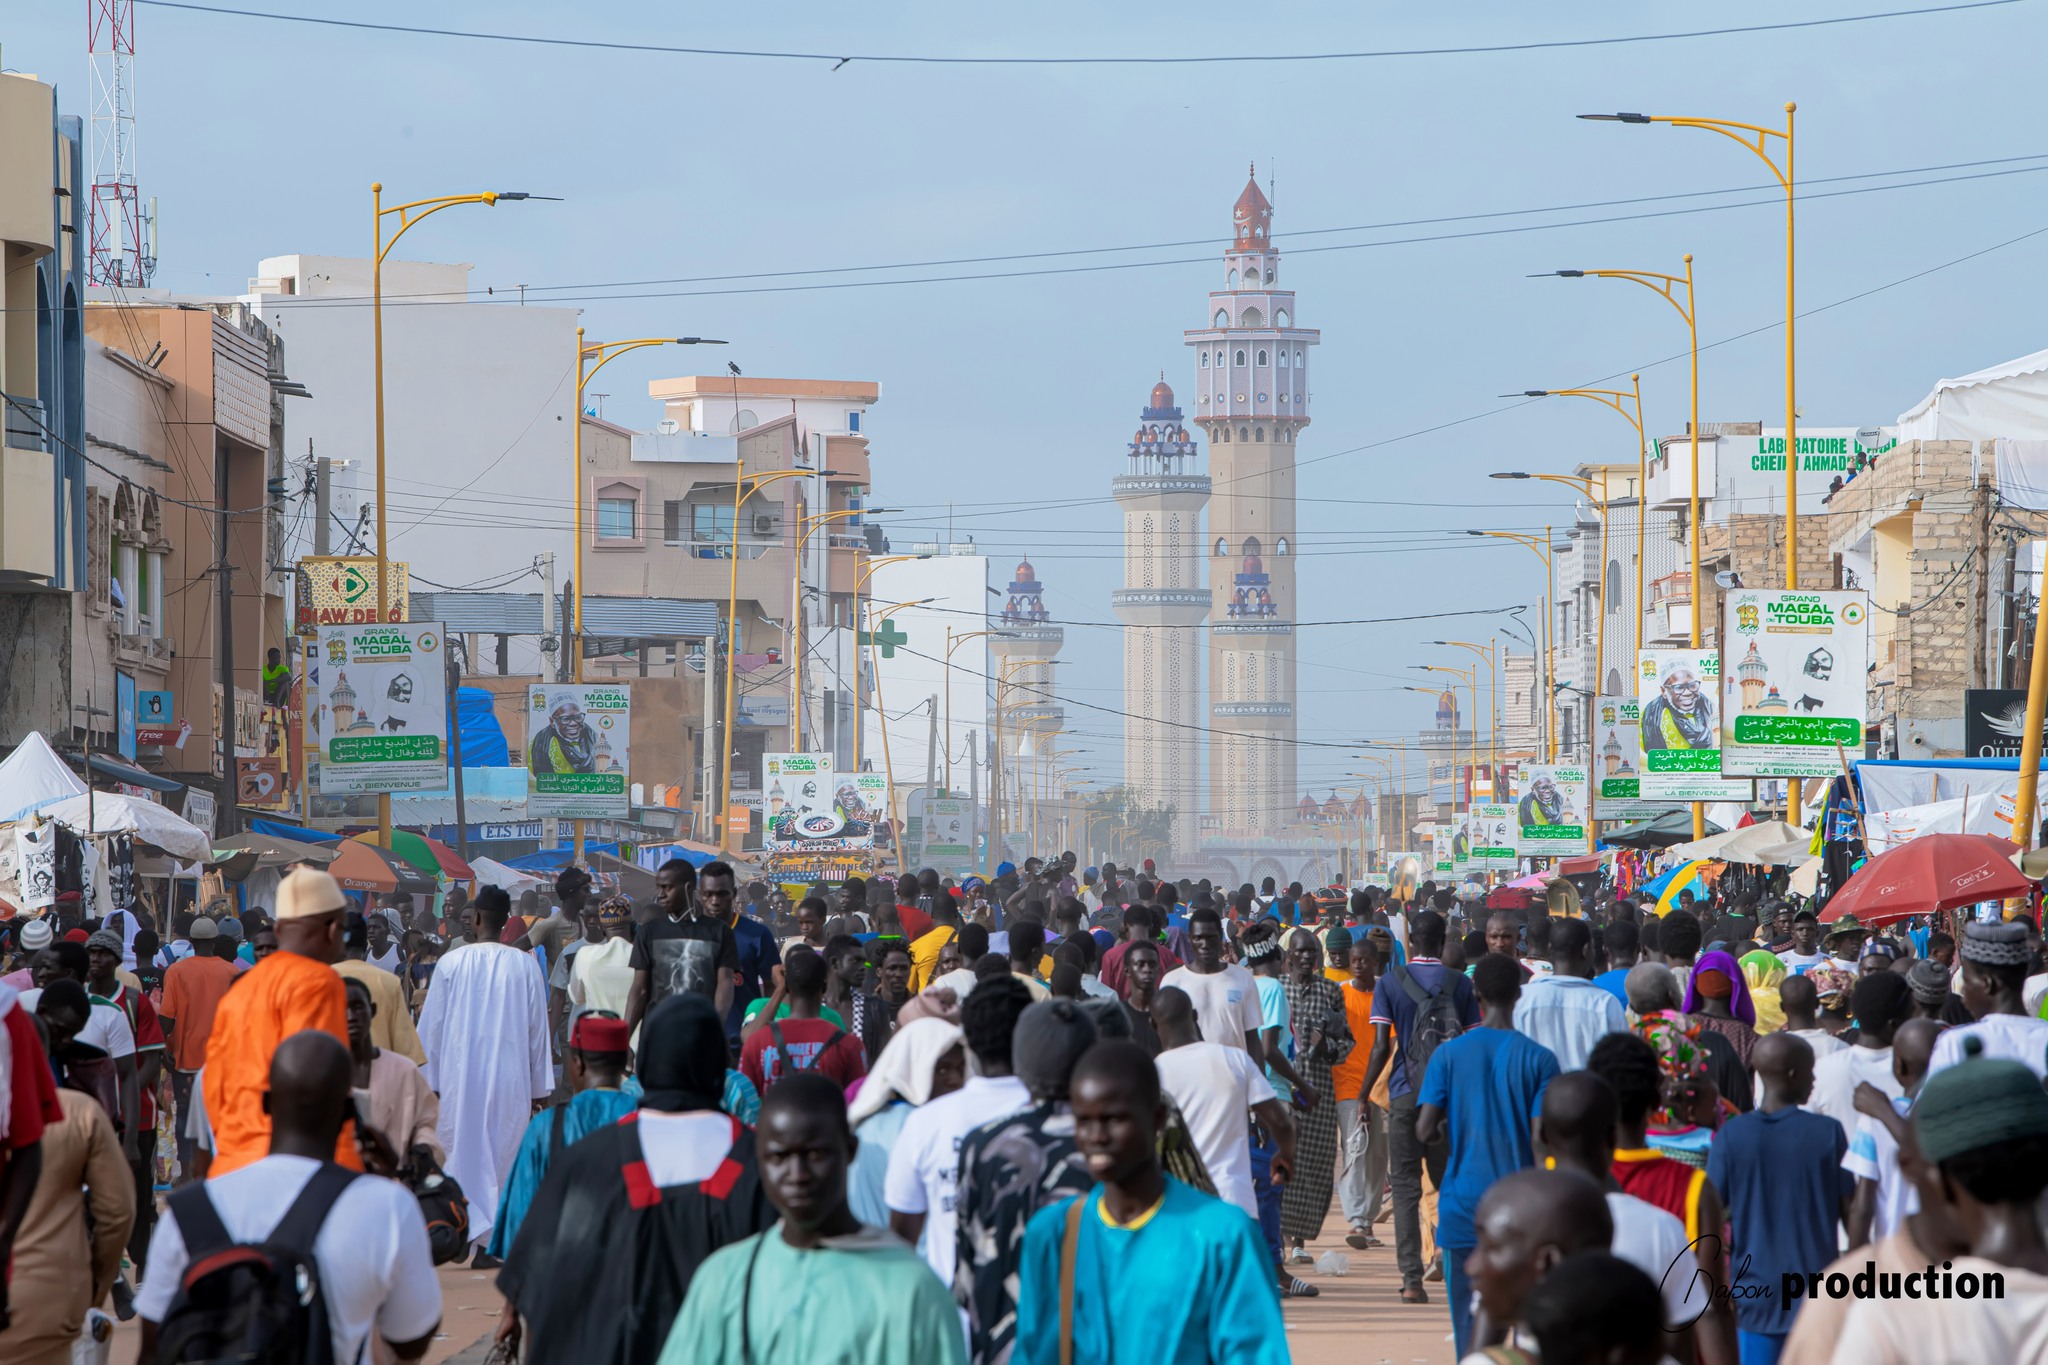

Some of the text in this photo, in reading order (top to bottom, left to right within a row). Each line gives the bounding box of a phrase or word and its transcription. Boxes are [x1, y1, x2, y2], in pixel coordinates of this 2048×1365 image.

[1759, 438, 1847, 454] LABRATOIRE
[1752, 456, 1799, 471] CHEI
[1781, 595, 1821, 603] GRAND
[1767, 603, 1834, 615] MAGAL
[300, 608, 401, 623] DIAW DEO
[1774, 614, 1835, 625] TOUBA
[354, 635, 411, 646] MAGAL
[360, 645, 412, 655] TOUBA
[589, 701, 628, 709] TOUBA
[138, 730, 164, 741] free
[1956, 868, 1989, 887] Cody's
[344, 878, 378, 889] Orange
